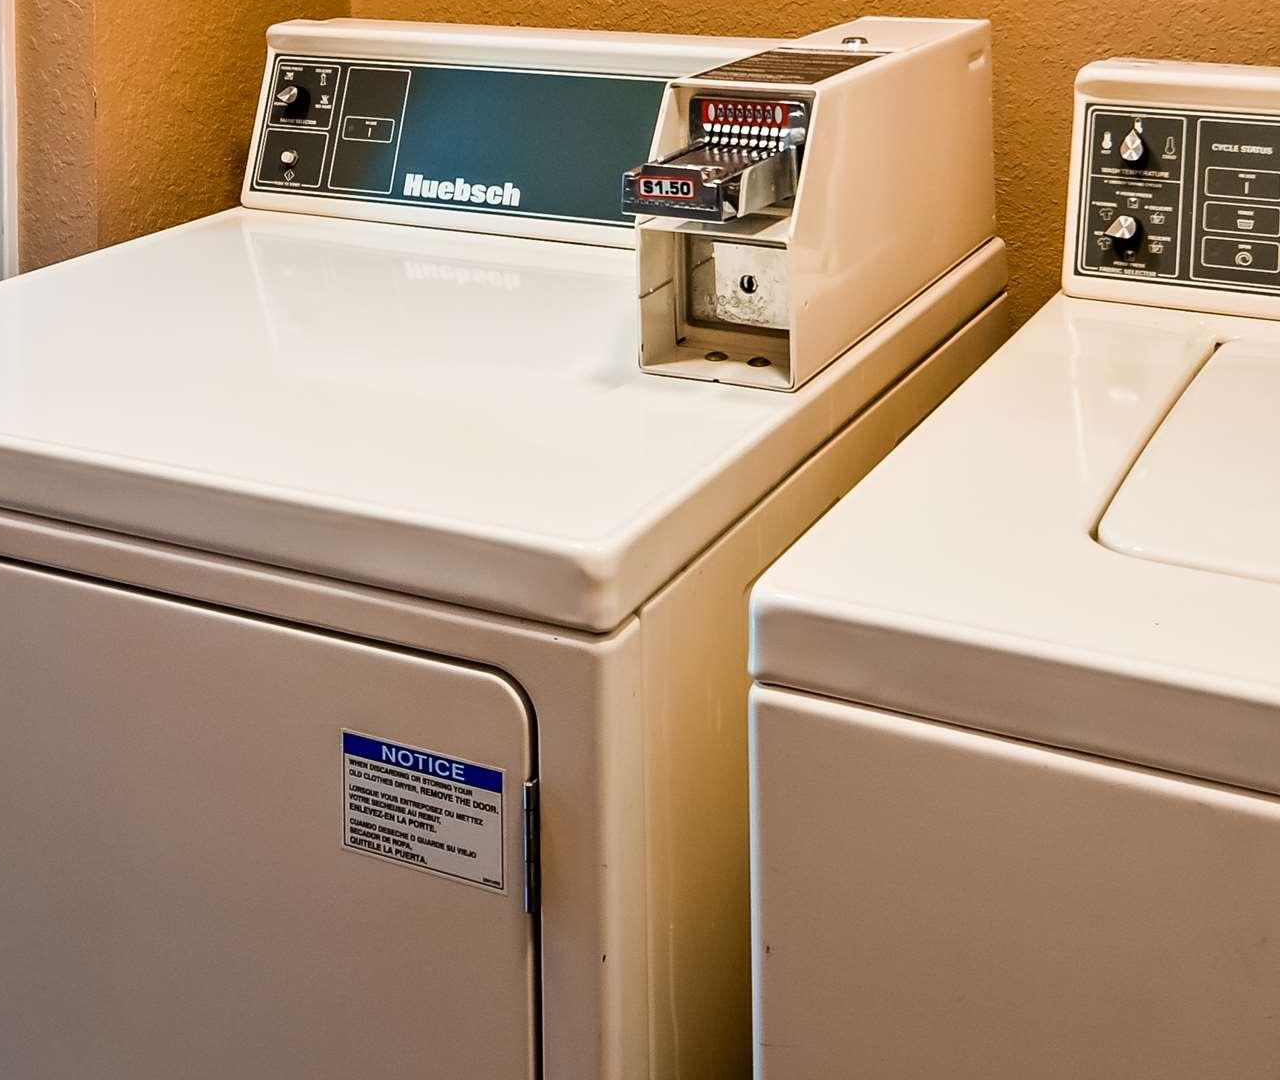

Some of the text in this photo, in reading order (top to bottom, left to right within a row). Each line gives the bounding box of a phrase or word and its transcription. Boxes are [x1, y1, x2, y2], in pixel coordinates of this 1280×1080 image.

[1211, 143, 1273, 155] CYCLE STATUS
[403, 173, 521, 207] Huebsch
[643, 180, 691, 196] $1.50
[349, 758, 368, 769] WHEN
[411, 774, 421, 783] OR
[422, 778, 452, 791] STORING
[453, 785, 473, 796] YOUR
[382, 745, 465, 781] NOTICE
[349, 769, 362, 778] OLD
[363, 773, 393, 786] CLOTHES
[420, 787, 454, 803] REMOVE
[455, 795, 471, 807] THE
[472, 800, 499, 814] DOOR.
[349, 792, 370, 805] VOTRE
[407, 808, 417, 817] AU
[349, 784, 380, 798] LORSQUE
[381, 791, 399, 803] VOUS
[444, 809, 454, 818] OU
[456, 813, 484, 826] METTEZ
[349, 803, 437, 833] ENLEVEZ-EN LA PORTE.
[350, 818, 377, 831] CUANDO
[410, 834, 416, 842] O
[446, 844, 456, 853] SU
[457, 847, 477, 859] VIEJO
[382, 835, 391, 844] DE
[383, 845, 393, 855] LA
[395, 848, 428, 864] PUERTA.
